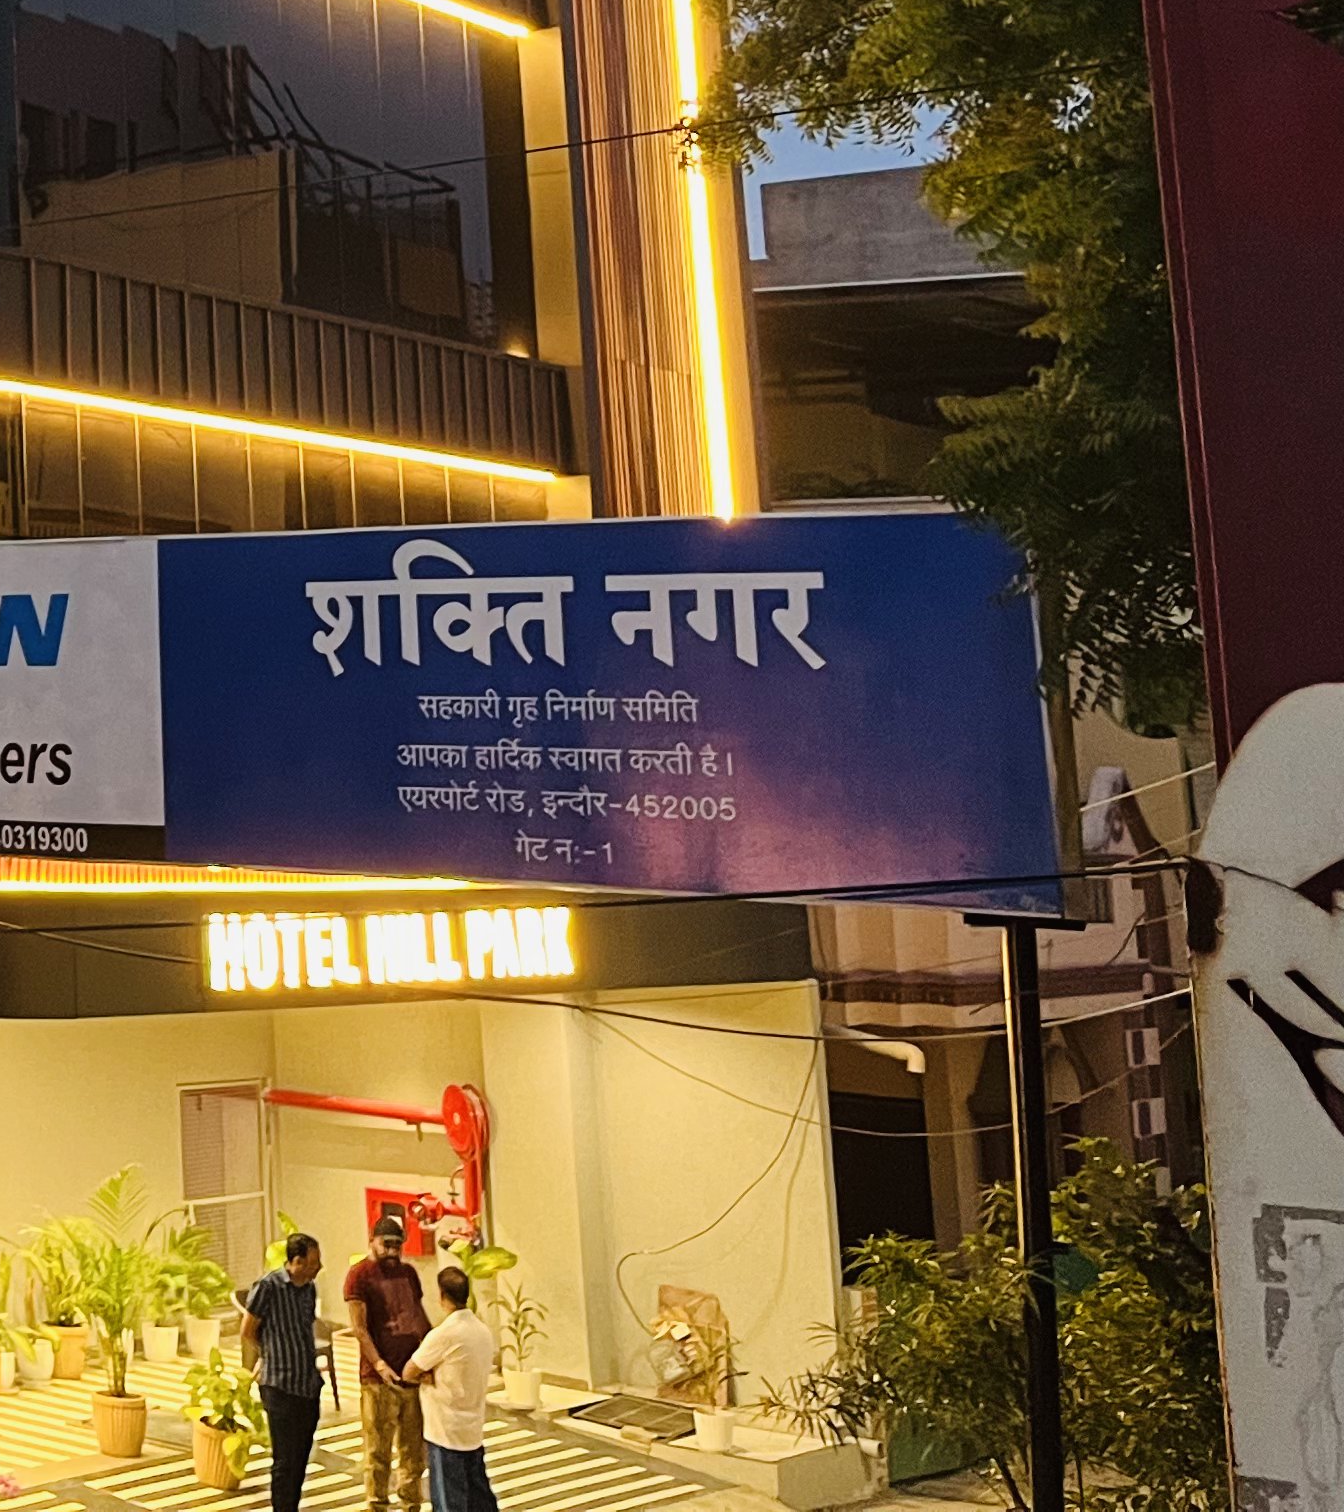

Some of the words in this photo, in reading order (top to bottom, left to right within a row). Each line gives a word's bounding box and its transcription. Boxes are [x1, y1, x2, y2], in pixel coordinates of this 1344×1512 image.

[305, 538, 574, 677] शक्ति
[604, 571, 827, 670] नगर
[417, 688, 500, 721] सहकारी
[507, 695, 538, 728] गृह
[544, 689, 614, 722] निर्माण
[622, 690, 698, 724] समिति
[396, 744, 469, 769] आपका
[473, 737, 543, 771] हार्दिक
[547, 747, 621, 774] स्वागत
[628, 742, 692, 776] करती
[397, 779, 480, 813] एयरपोर्ट
[485, 781, 534, 818] रोड,
[514, 828, 549, 863] गेट
[206, 911, 362, 992] HOTEL
[364, 910, 463, 985] HILL
[463, 905, 575, 980] PARK
